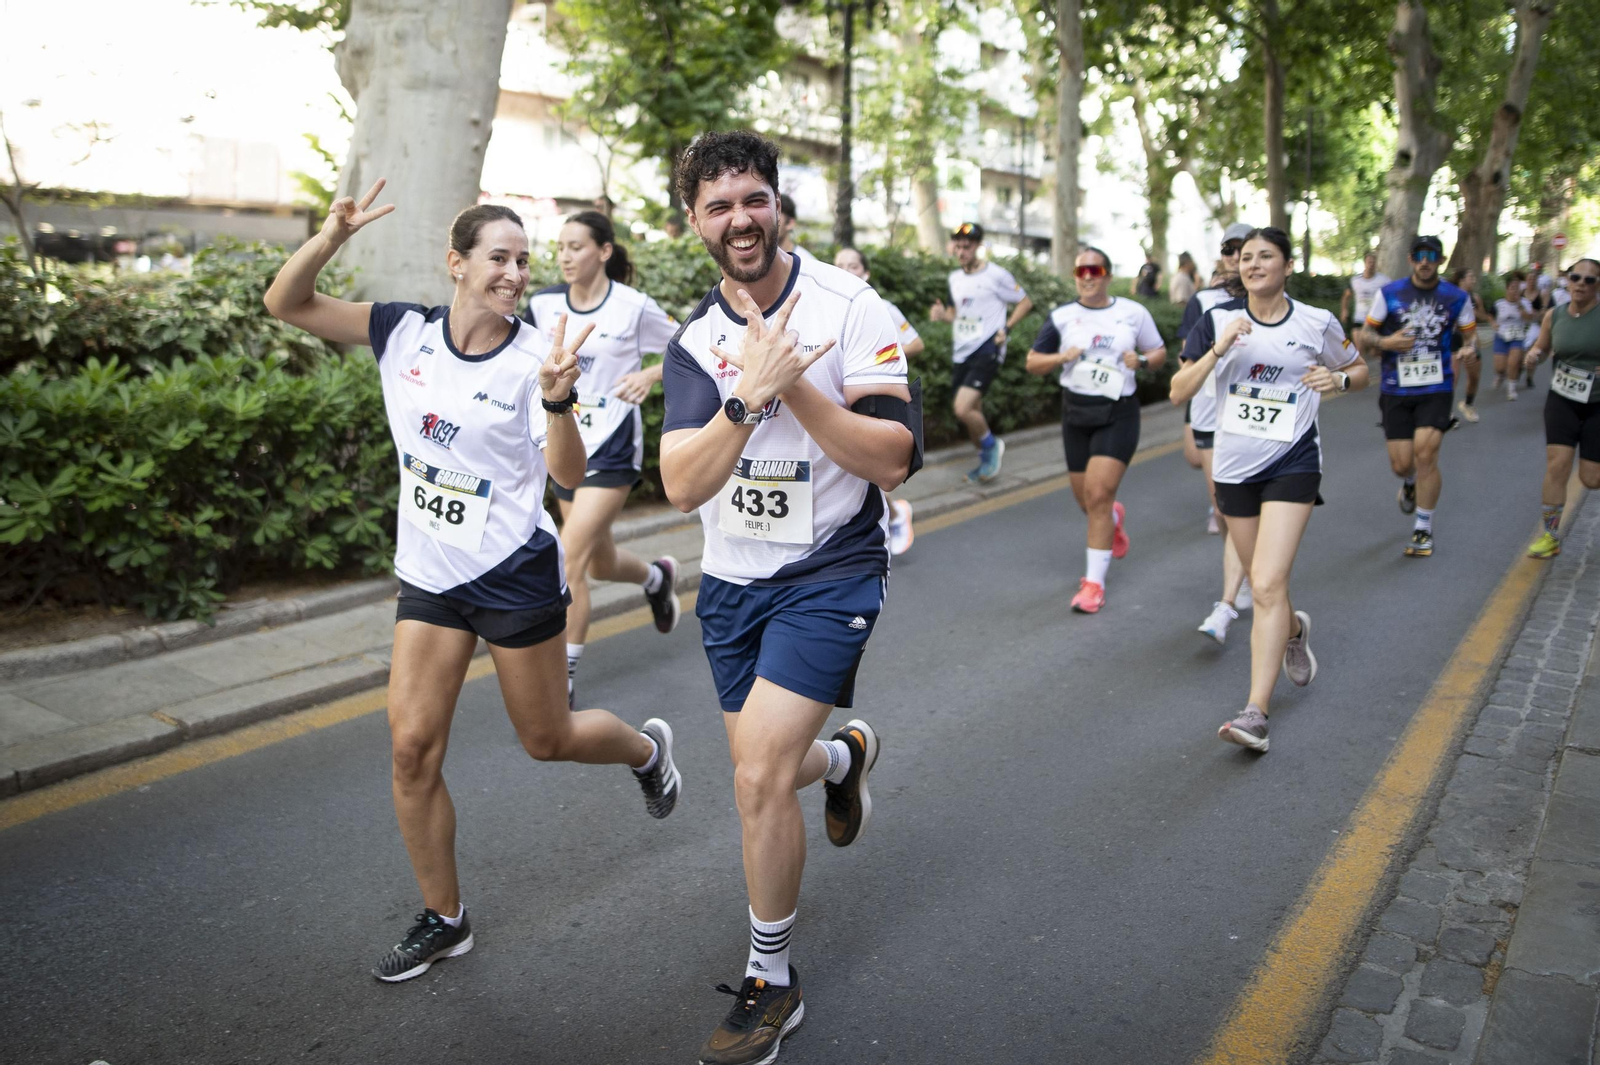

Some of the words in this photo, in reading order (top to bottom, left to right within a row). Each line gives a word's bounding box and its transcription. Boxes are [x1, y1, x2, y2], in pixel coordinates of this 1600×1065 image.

[1090, 368, 1109, 383] 18
[1403, 365, 1438, 377] 2128
[1556, 372, 1587, 393] 2129
[491, 399, 516, 411] mupol
[1238, 403, 1282, 424] 337
[749, 460, 798, 477] GRANADA
[434, 469, 482, 493] GRANADA
[414, 485, 466, 526] 648
[731, 485, 789, 519] 433
[745, 520, 764, 531] FELIPE
